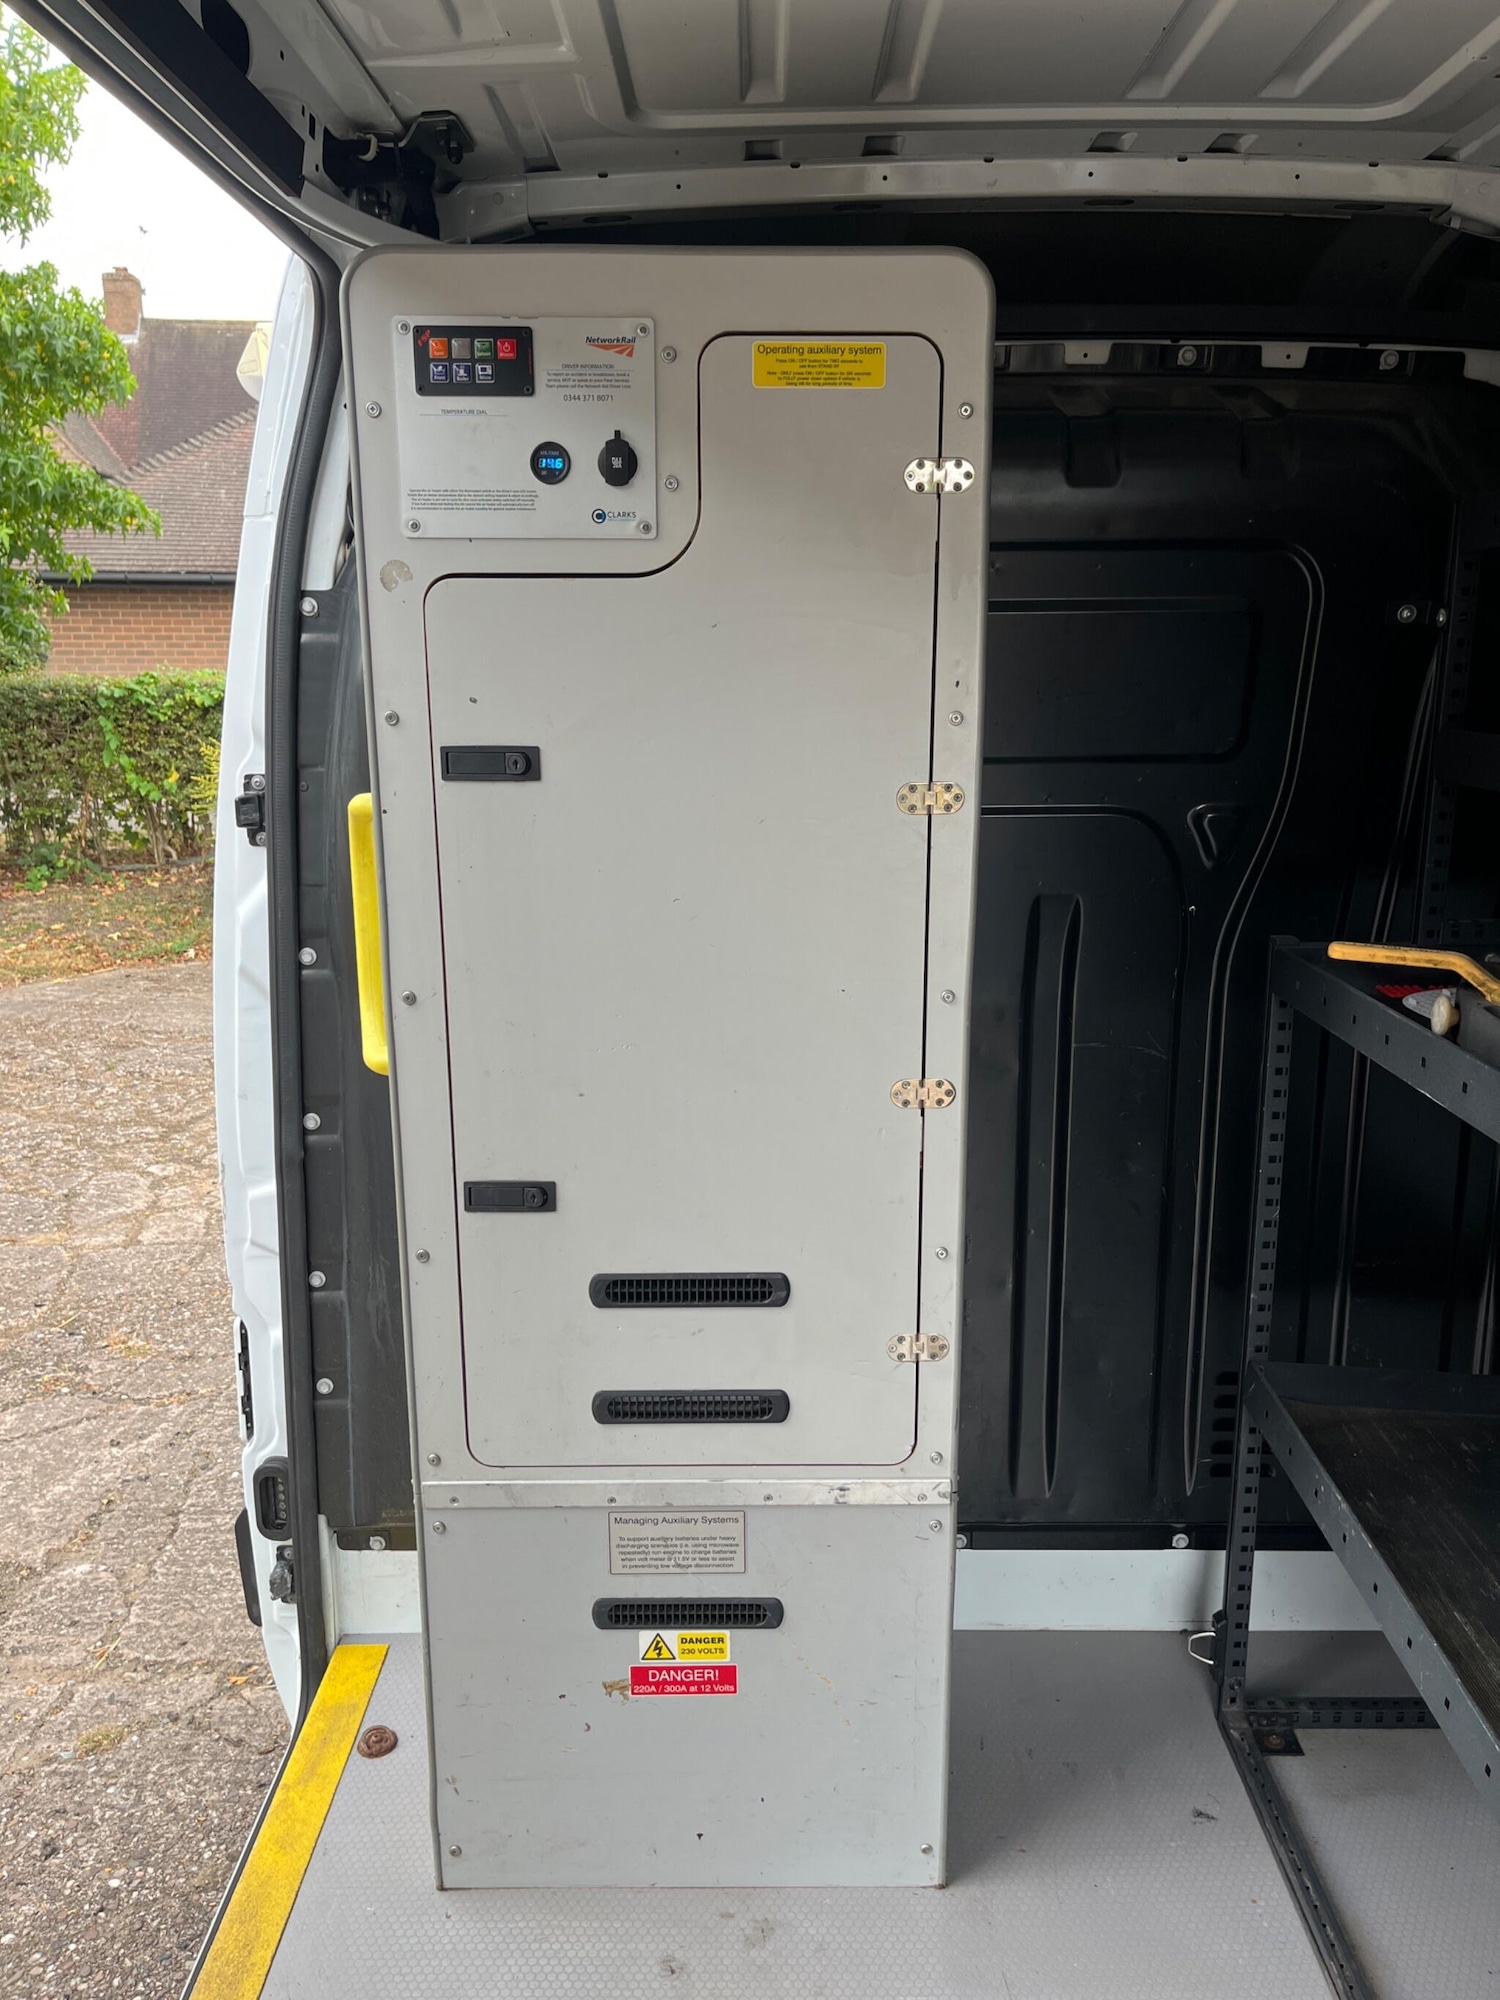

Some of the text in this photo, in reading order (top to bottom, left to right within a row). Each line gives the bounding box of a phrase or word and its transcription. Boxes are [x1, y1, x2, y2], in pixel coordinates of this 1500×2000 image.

[757, 344, 881, 356] Operating auxiliary system
[614, 1516, 739, 1525] Managing Auxiliary Systems
[648, 1669, 719, 1682] DANGER!
